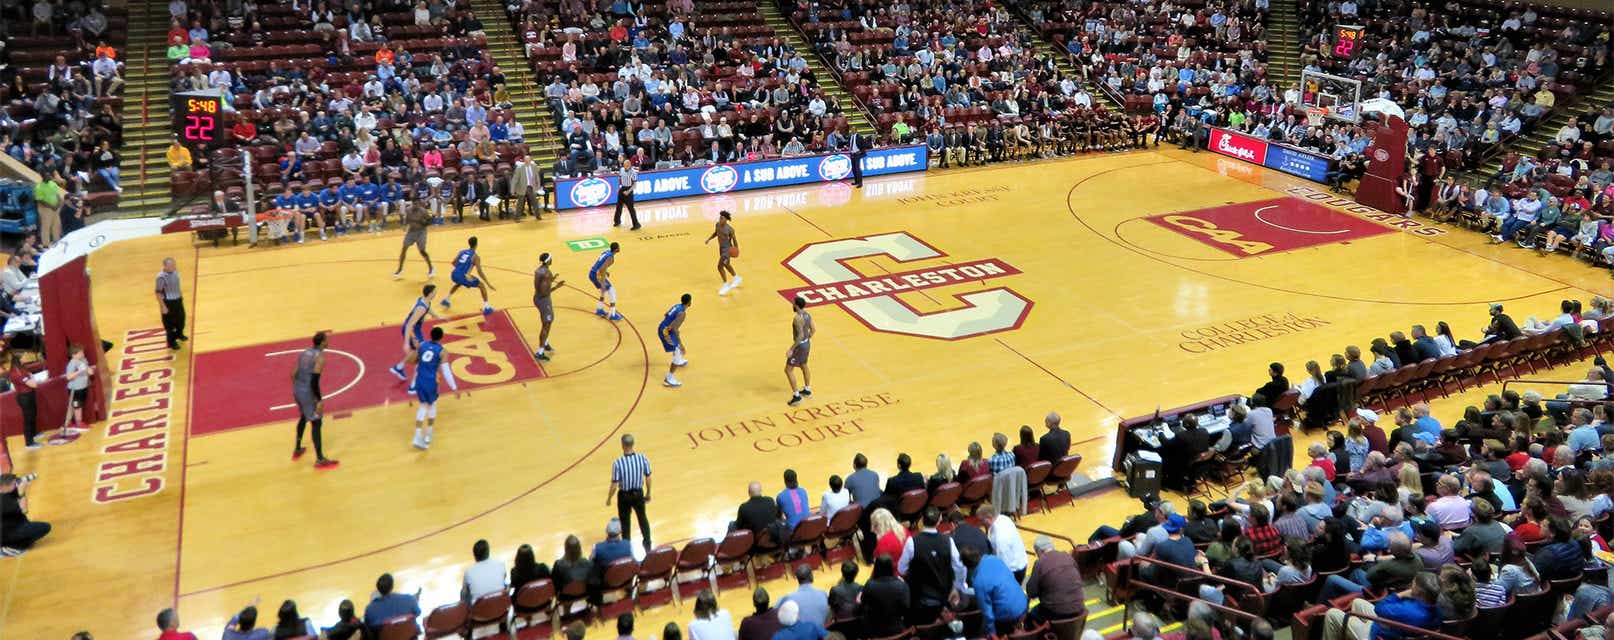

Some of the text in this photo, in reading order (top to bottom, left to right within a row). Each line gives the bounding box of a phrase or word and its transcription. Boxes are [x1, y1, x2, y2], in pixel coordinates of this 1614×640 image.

[1335, 39, 1354, 58] 22
[188, 98, 217, 113] 5:48
[185, 115, 215, 141] 22
[743, 170, 752, 184] A
[753, 166, 775, 183] SUB
[776, 163, 811, 181] ABOVE.
[866, 155, 885, 170] SUB
[887, 152, 918, 167] ABOVE.
[653, 175, 693, 193] ABOVE.
[1287, 184, 1450, 237] COUGARS
[572, 238, 607, 250] TD
[1162, 214, 1275, 256] CAA
[796, 261, 1008, 304] CHARLESTON
[1178, 316, 1332, 354] CHARLESTON
[1180, 313, 1278, 341] COLLEGE
[421, 350, 434, 362] 0
[431, 314, 516, 384] CAA
[93, 326, 175, 503] CHARLESTON
[685, 392, 900, 450] JOHN KRESSE
[753, 418, 866, 453] COURT
